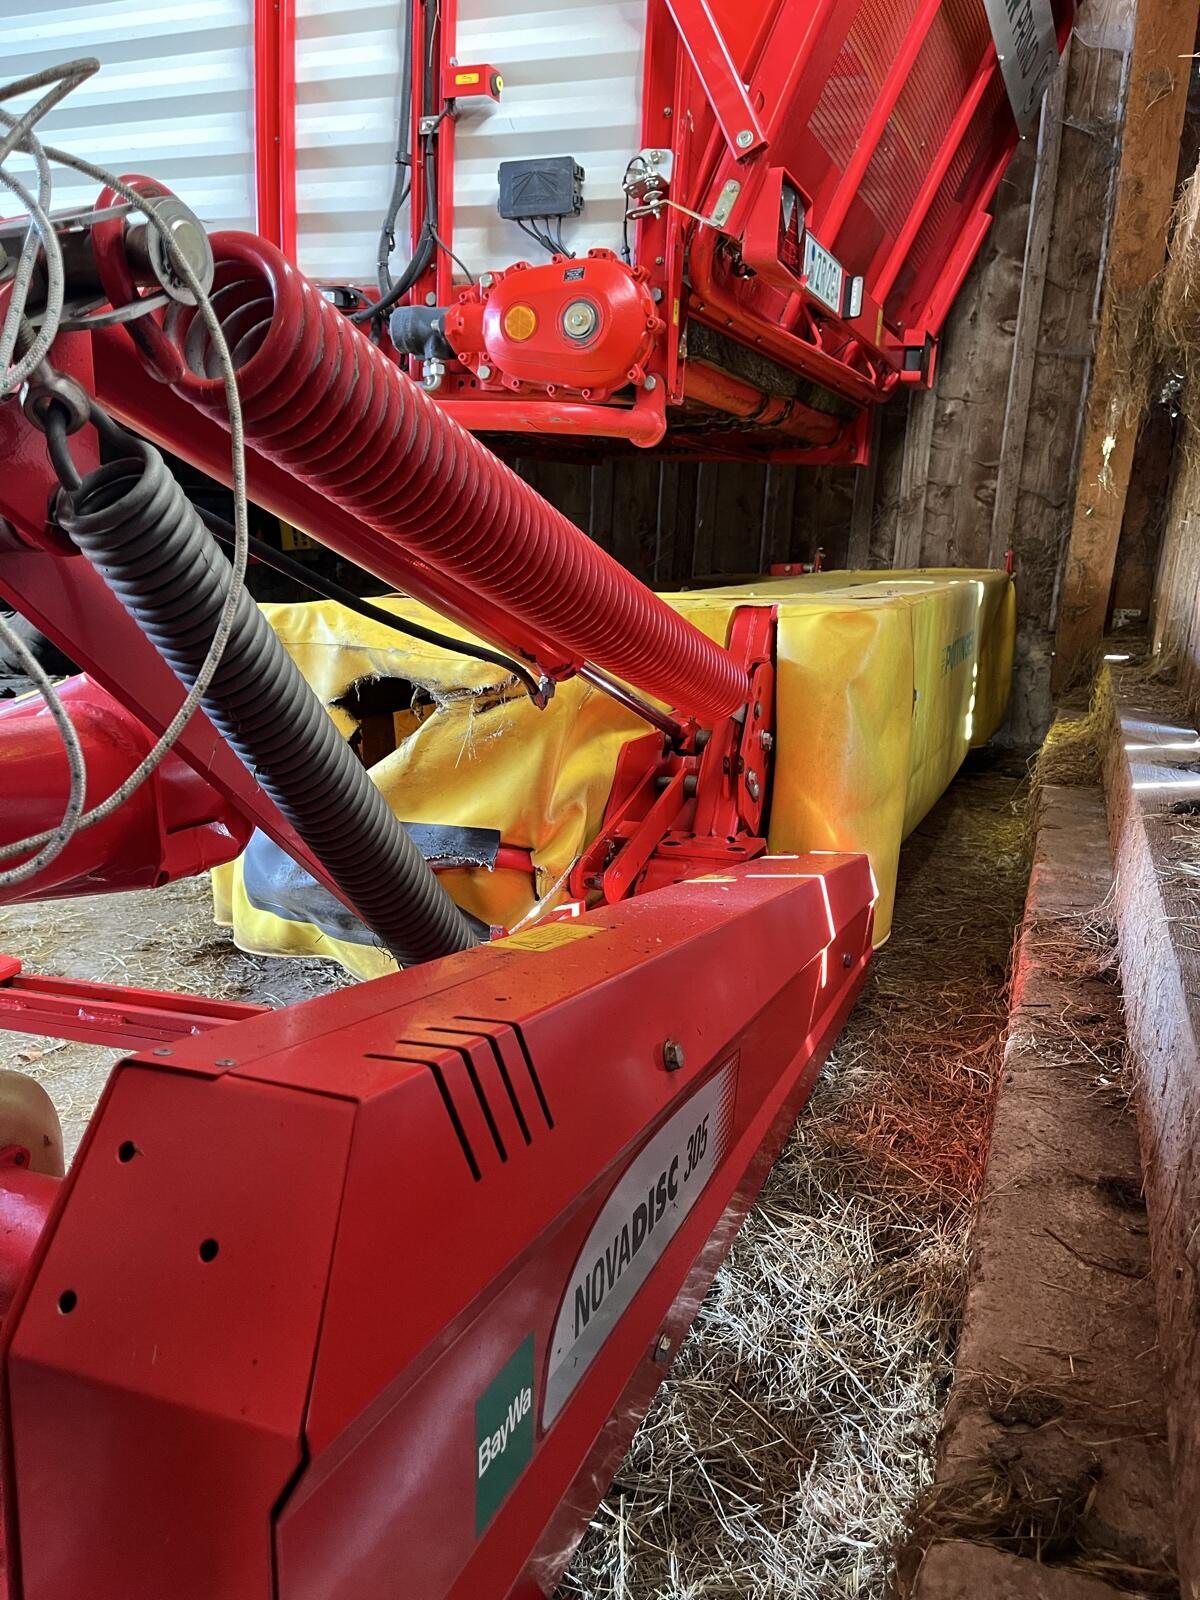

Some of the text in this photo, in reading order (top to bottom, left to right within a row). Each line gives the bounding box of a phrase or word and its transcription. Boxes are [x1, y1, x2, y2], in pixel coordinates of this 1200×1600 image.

[1012, 0, 1039, 79] PRIMO
[575, 1112, 710, 1340] NOVADISC 305
[478, 1387, 532, 1479] BayWa
